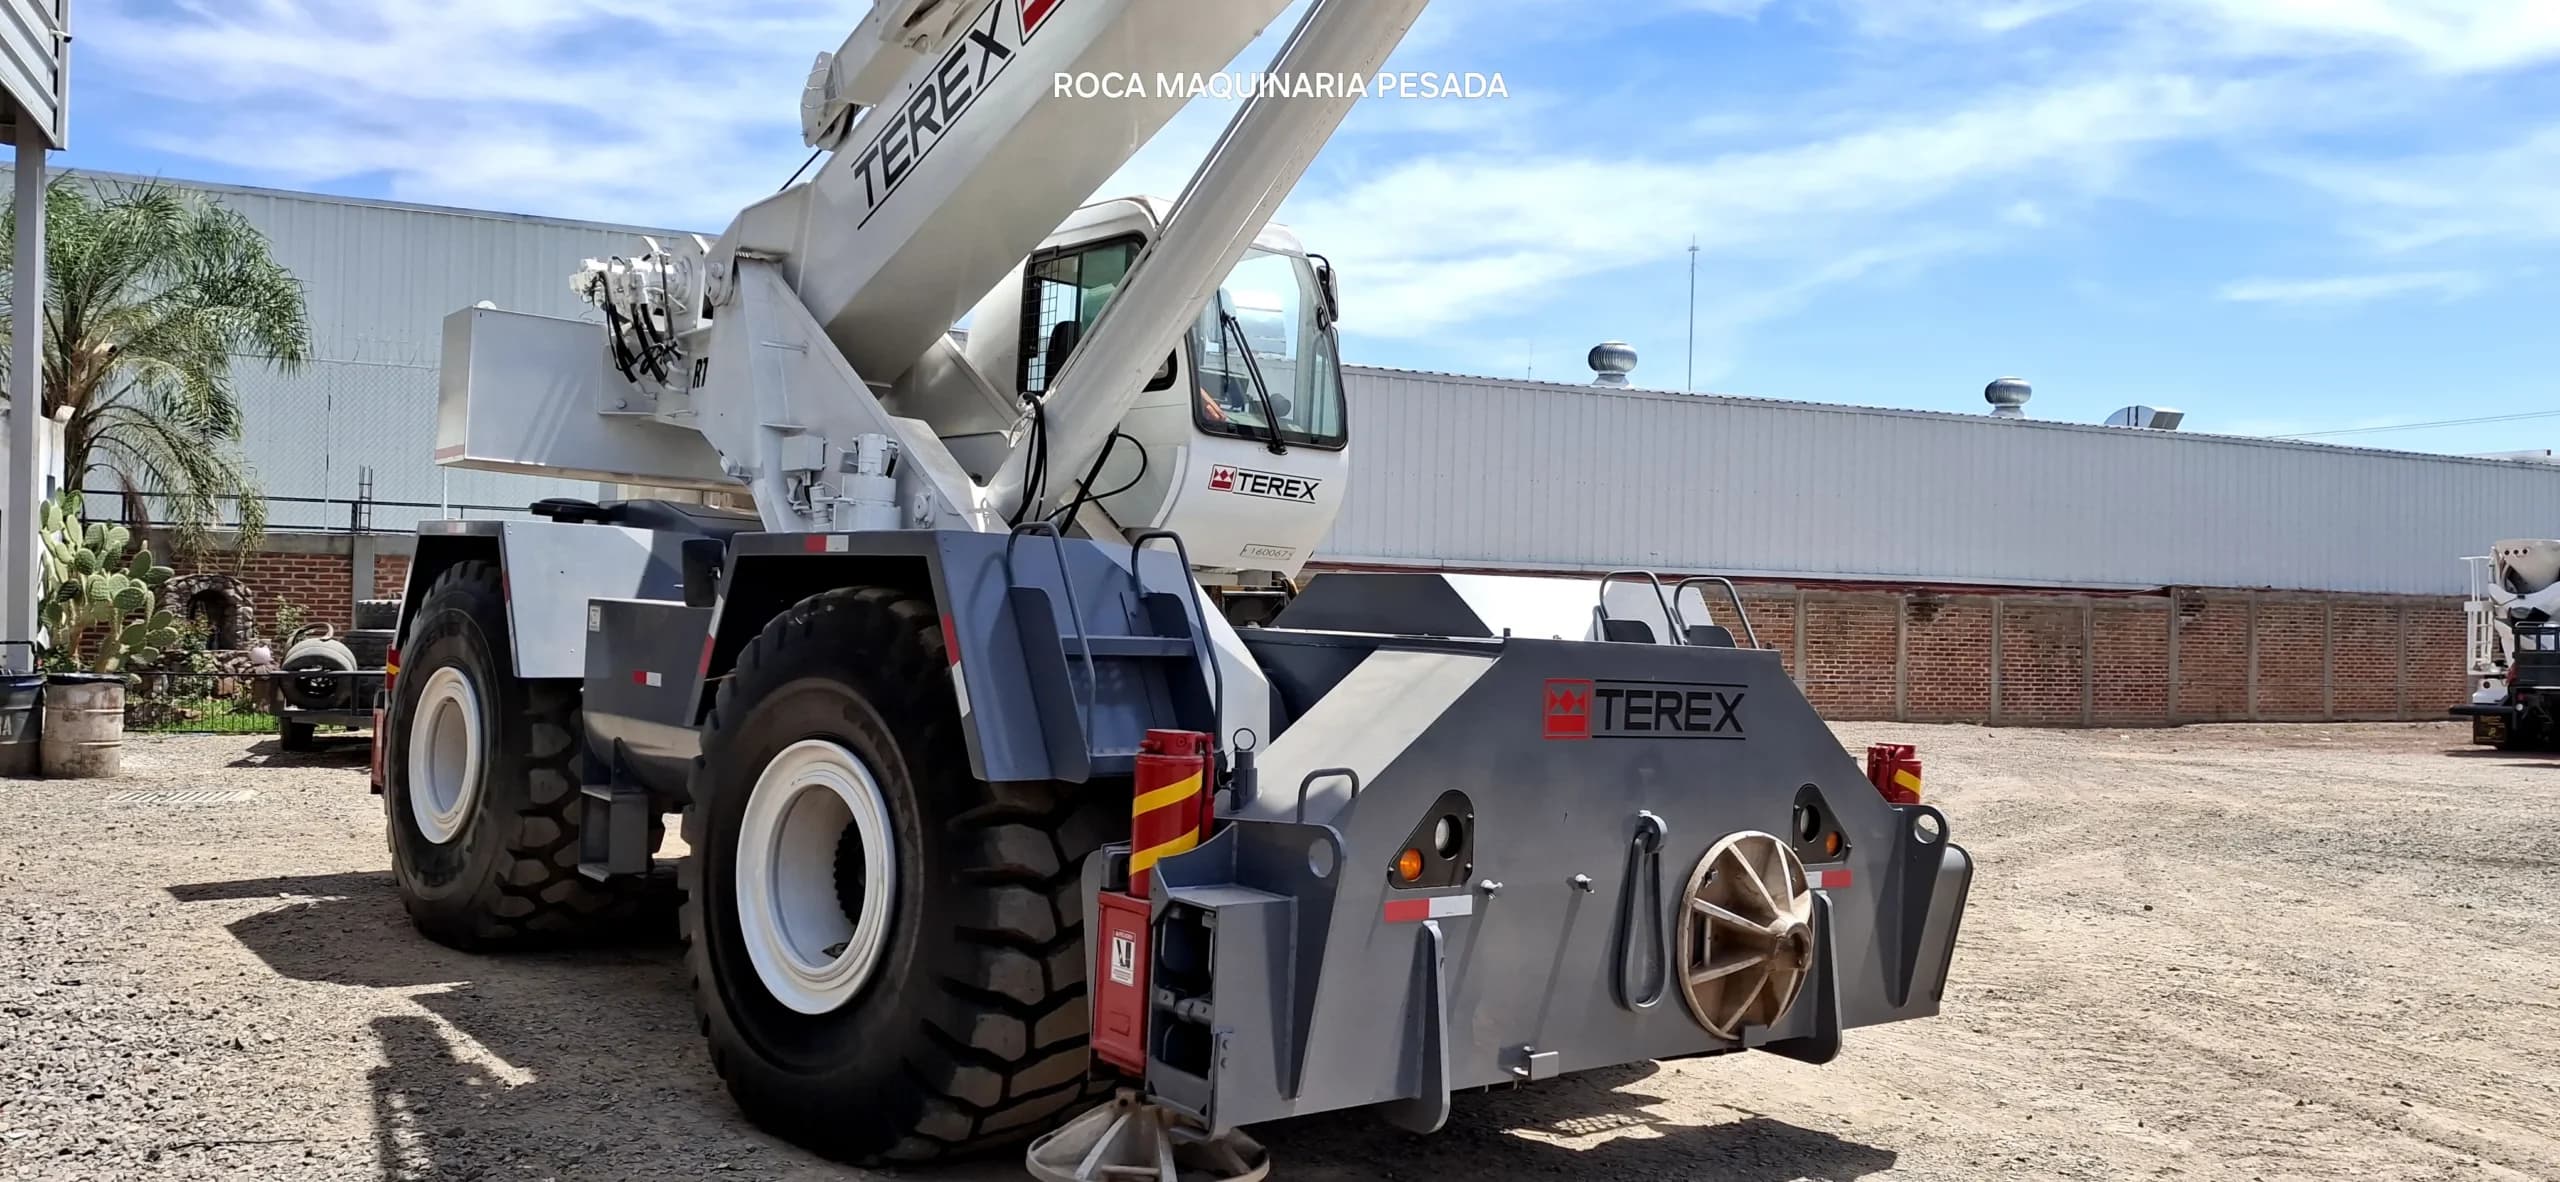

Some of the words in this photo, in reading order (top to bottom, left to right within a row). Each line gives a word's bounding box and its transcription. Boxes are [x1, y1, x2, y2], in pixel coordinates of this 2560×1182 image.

[855, 0, 1011, 209] TEREX
[1238, 472, 1319, 500] TEREX
[1595, 689, 1745, 732] TEREX
